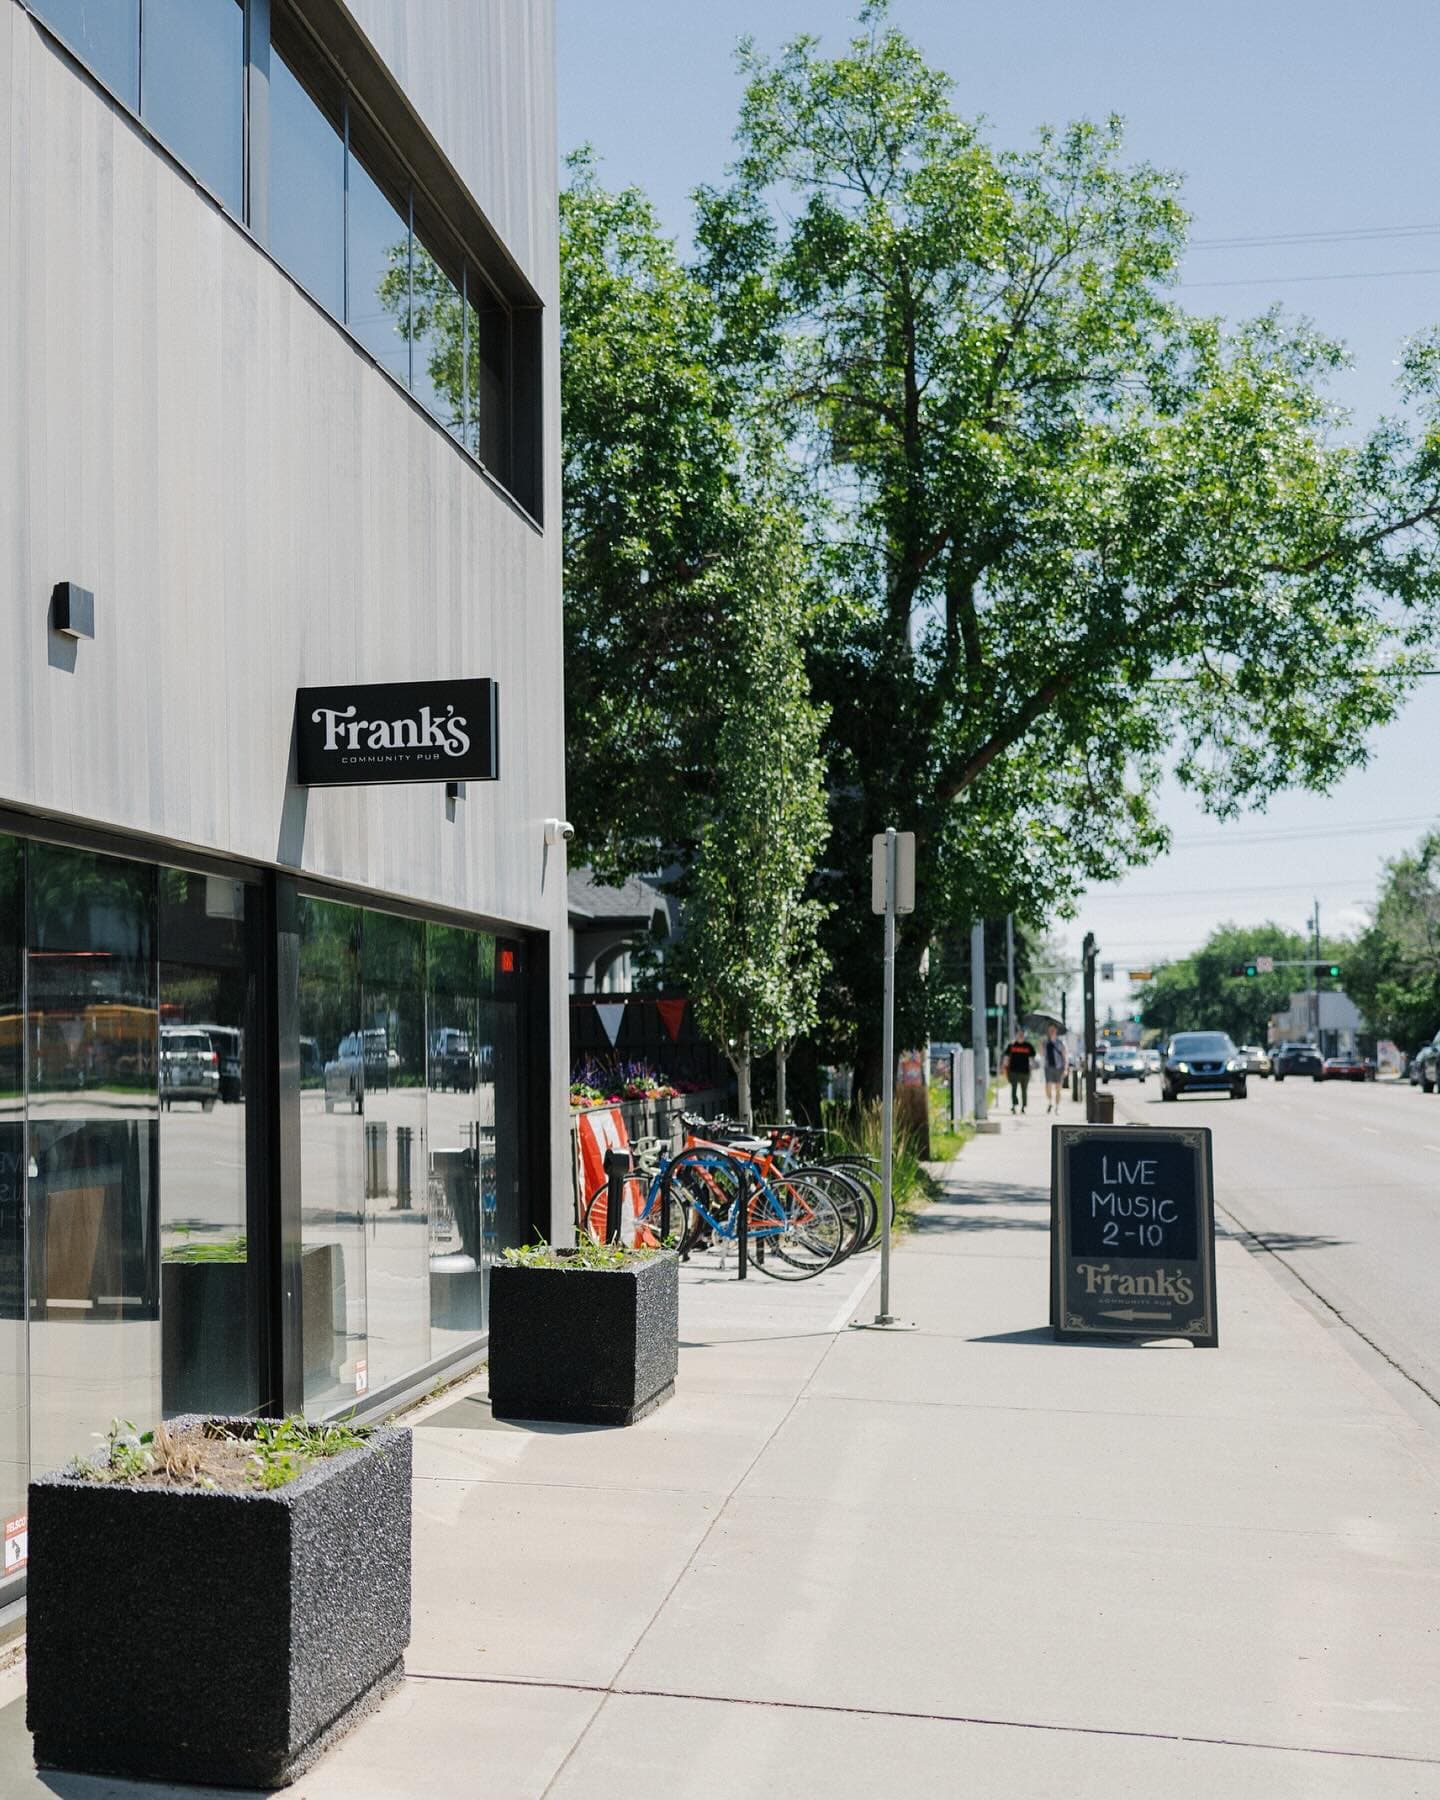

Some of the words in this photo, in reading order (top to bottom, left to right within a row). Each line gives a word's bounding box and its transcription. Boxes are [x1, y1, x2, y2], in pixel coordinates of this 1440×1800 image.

[312, 704, 470, 757] Frank's
[341, 754, 411, 763] COMMUNITY
[416, 753, 440, 761] PUB
[1102, 1155, 1159, 1185] LIVE
[1091, 1191, 1178, 1223] MUSIC
[1102, 1221, 1163, 1247] 2-10
[1076, 1263, 1194, 1305] Frank's
